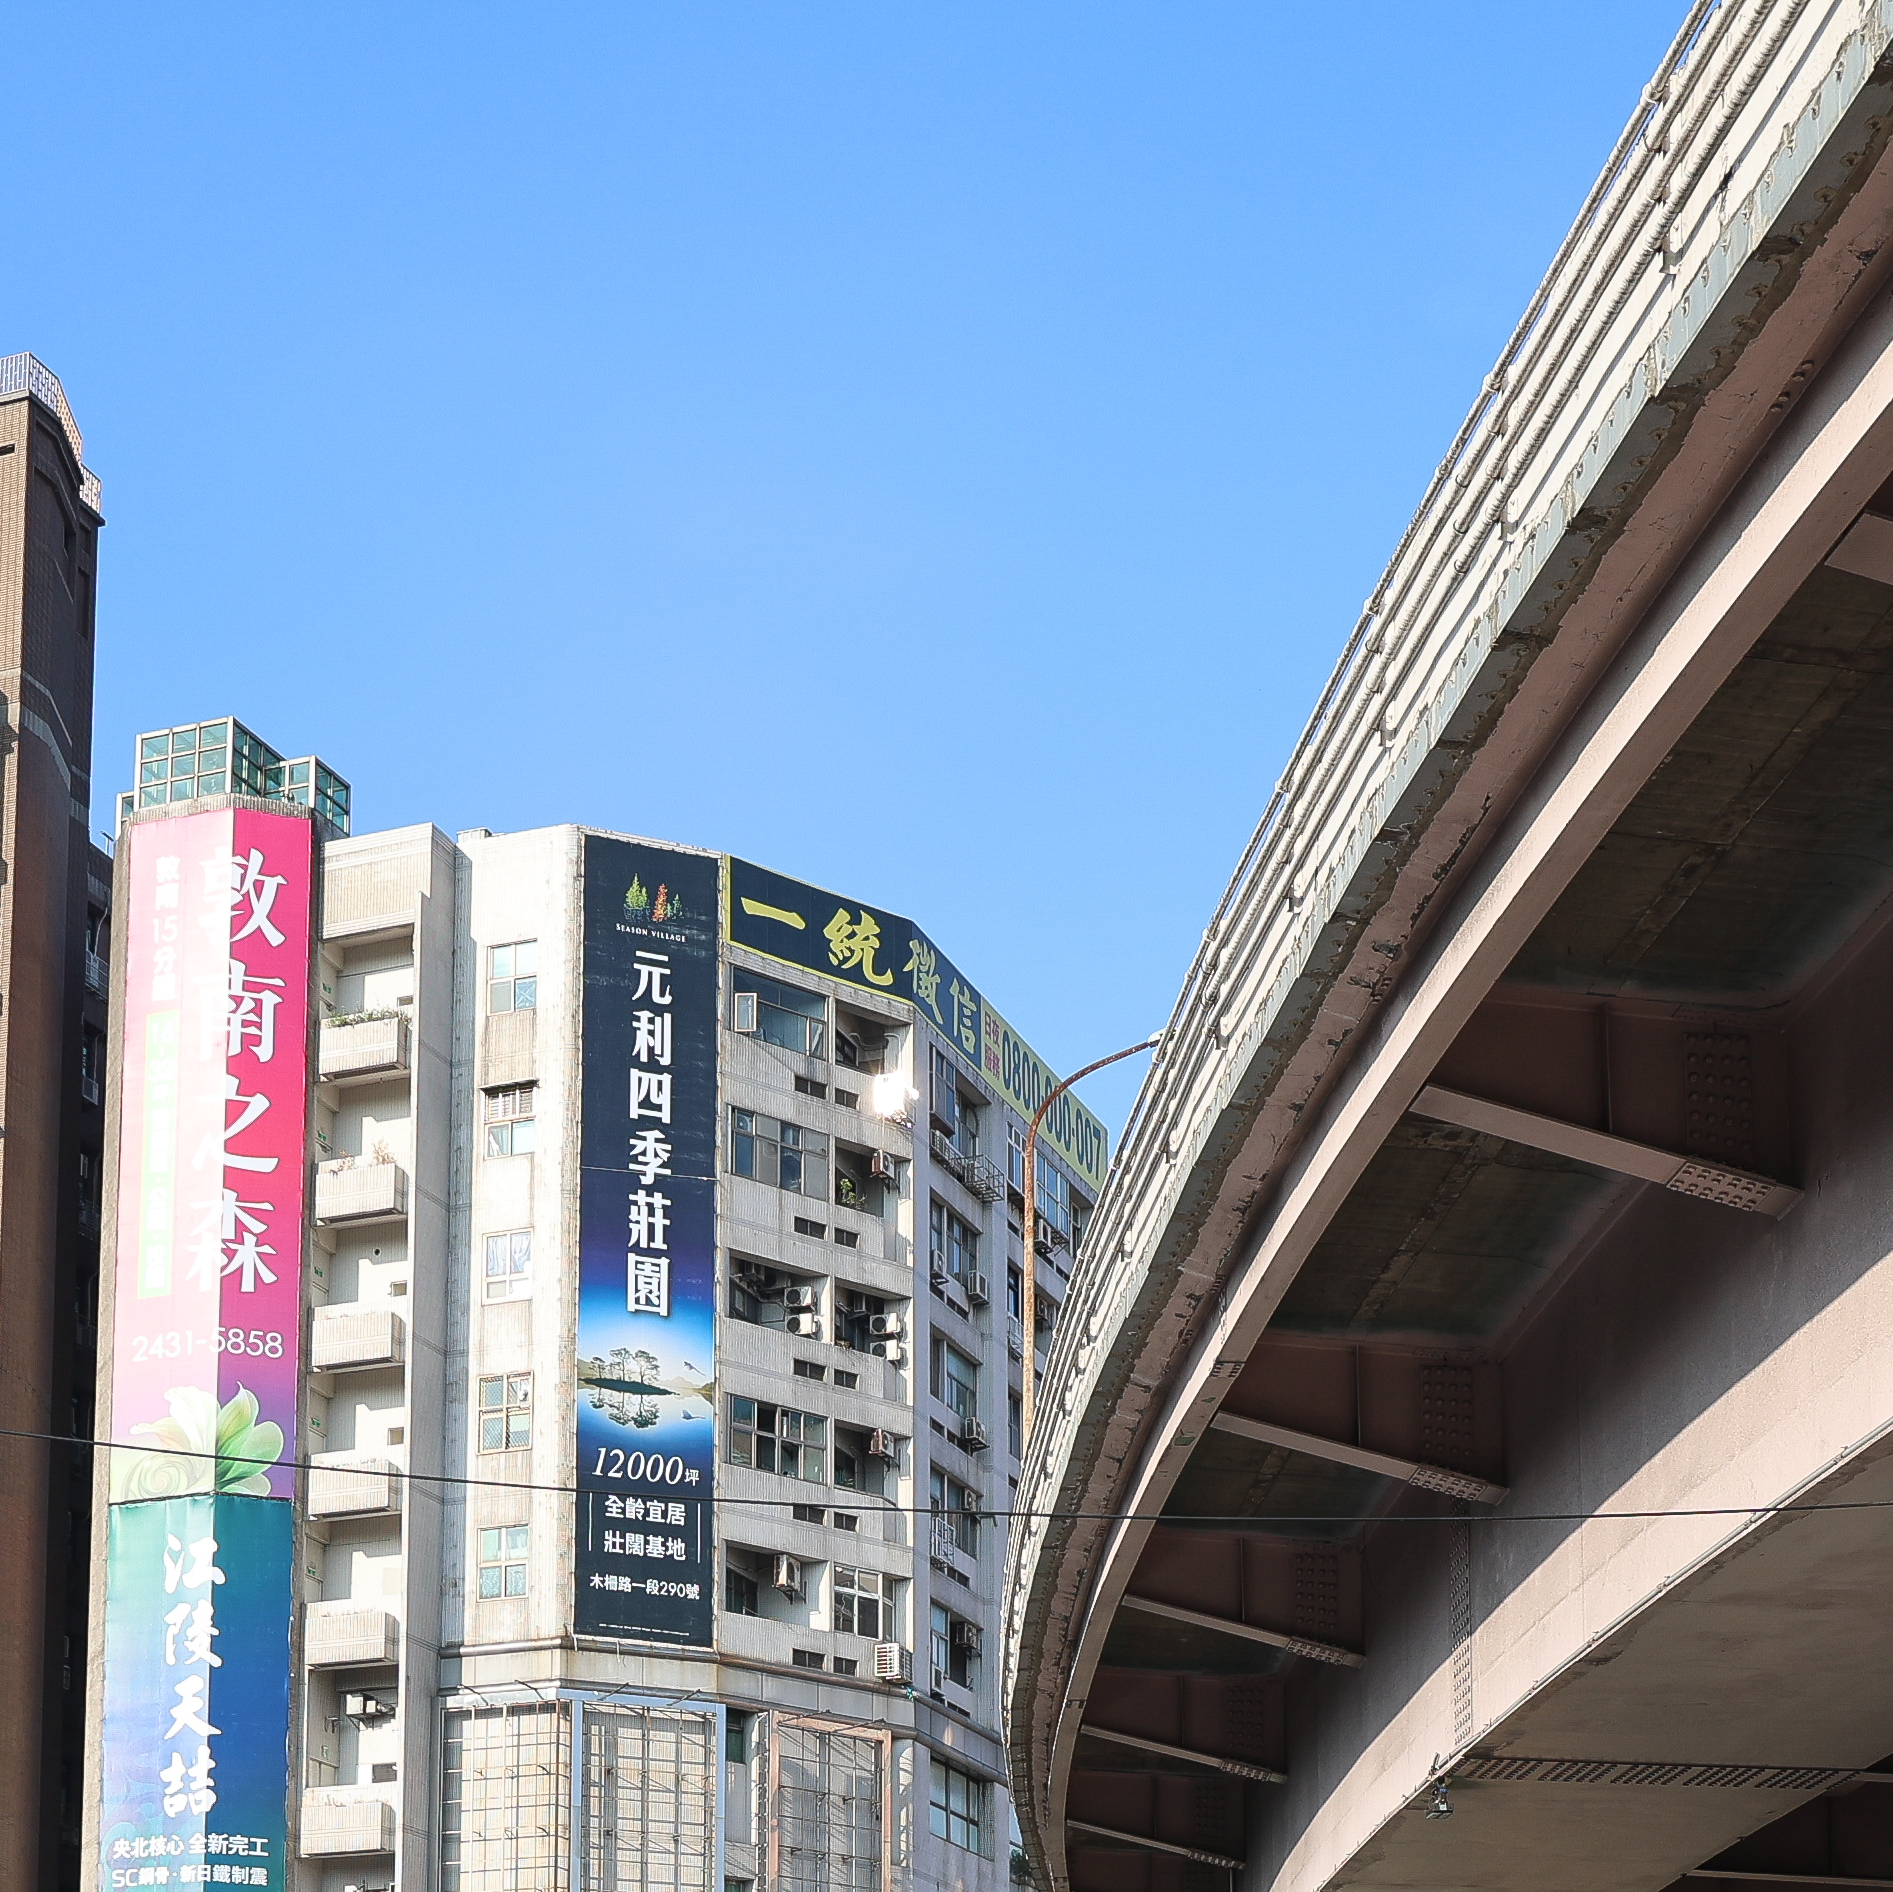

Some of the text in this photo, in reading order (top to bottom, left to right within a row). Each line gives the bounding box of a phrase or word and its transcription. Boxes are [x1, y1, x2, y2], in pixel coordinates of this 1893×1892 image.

[616, 923, 687, 943] SEASON VILLAGE
[741, 896, 976, 1055] 一統徵信
[984, 1010, 1000, 1048] 日夜
[185, 846, 288, 1294] 敦南之森
[627, 951, 673, 1318] 元利四季莊園
[132, 1327, 283, 1363] 2431-5858
[591, 1447, 700, 1486] 12000坪
[604, 1494, 686, 1526] 全齡宜居
[603, 1529, 686, 1561] 壯闊基地
[589, 1572, 700, 1600] 木柵路一段290號
[159, 1532, 226, 1818] 江陵天喆
[113, 1833, 270, 1859] 央北核心 全新完工
